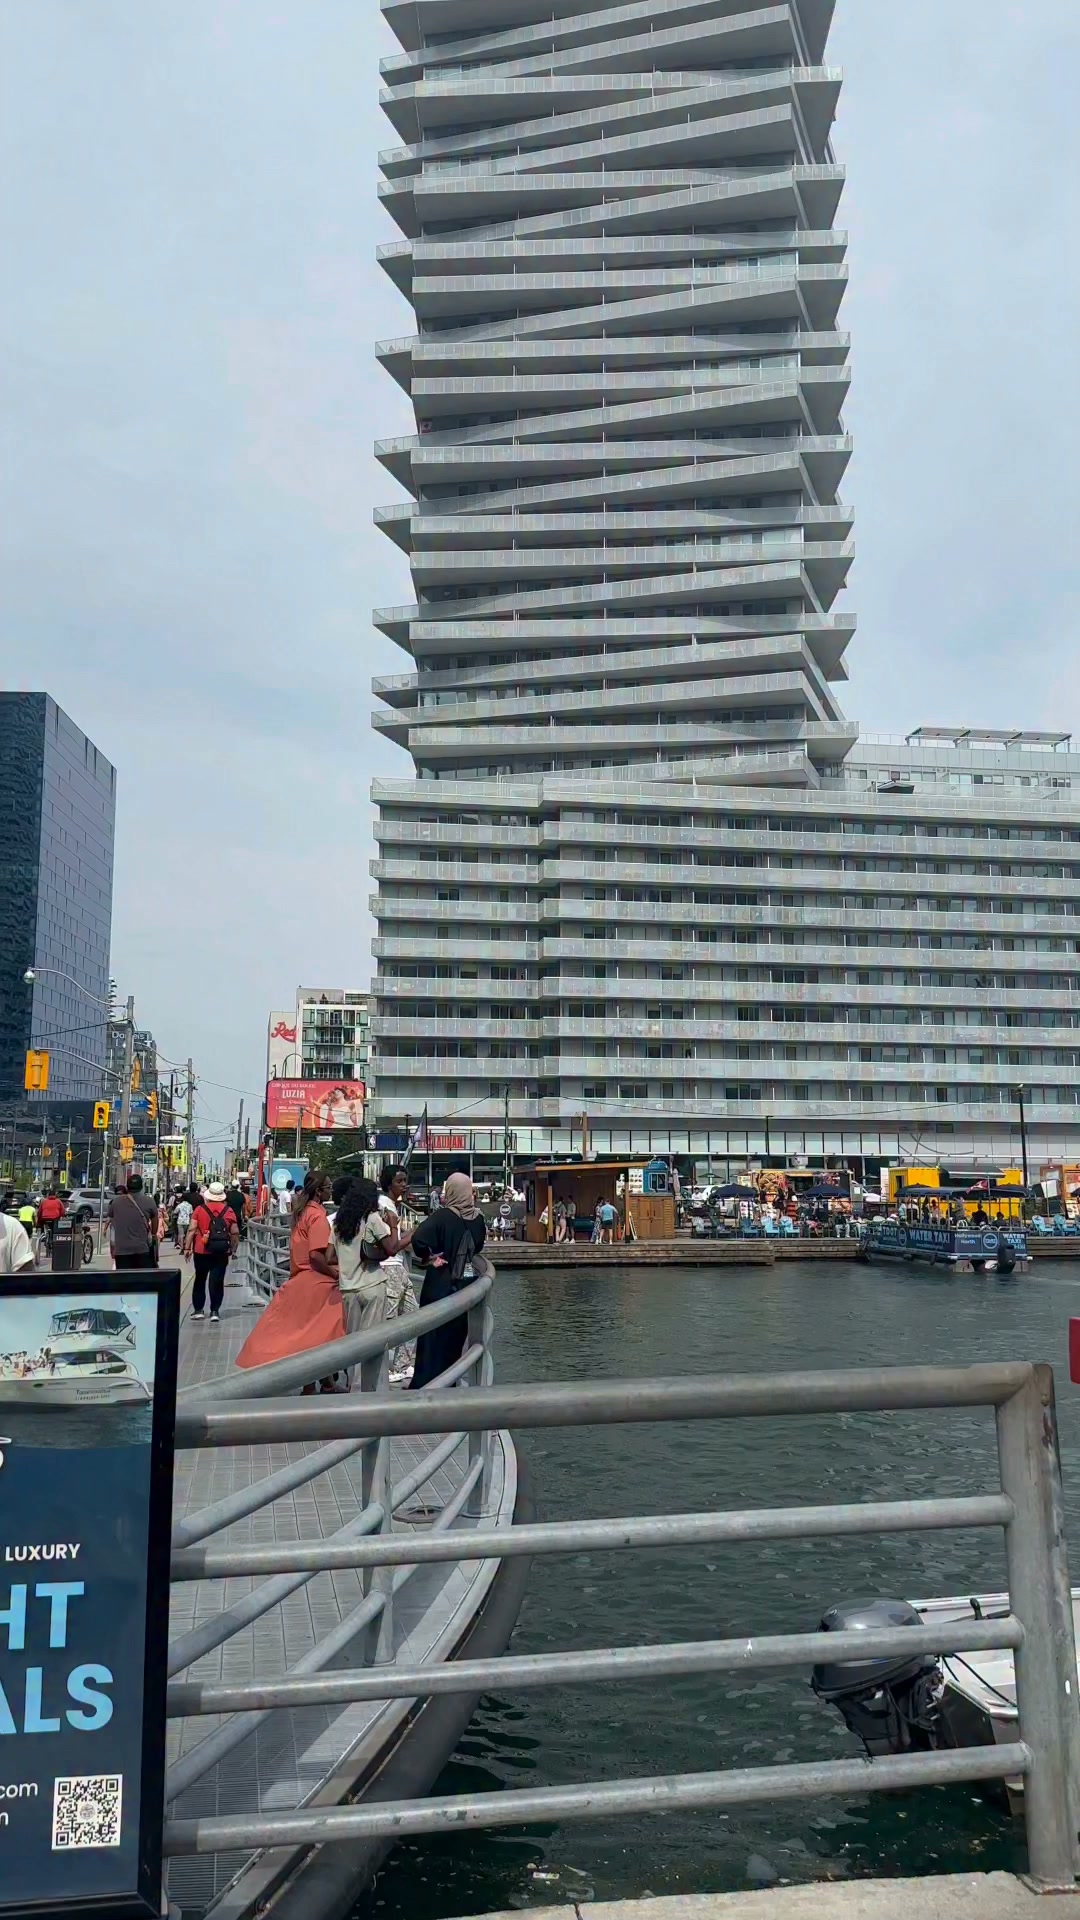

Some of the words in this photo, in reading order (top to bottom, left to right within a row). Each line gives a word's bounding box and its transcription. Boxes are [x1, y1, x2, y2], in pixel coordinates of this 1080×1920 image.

[282, 1089, 306, 1099] LUZIA
[909, 1229, 933, 1242] WATER
[934, 1231, 951, 1244] TAXI
[5, 1543, 81, 1562] LUXURY
